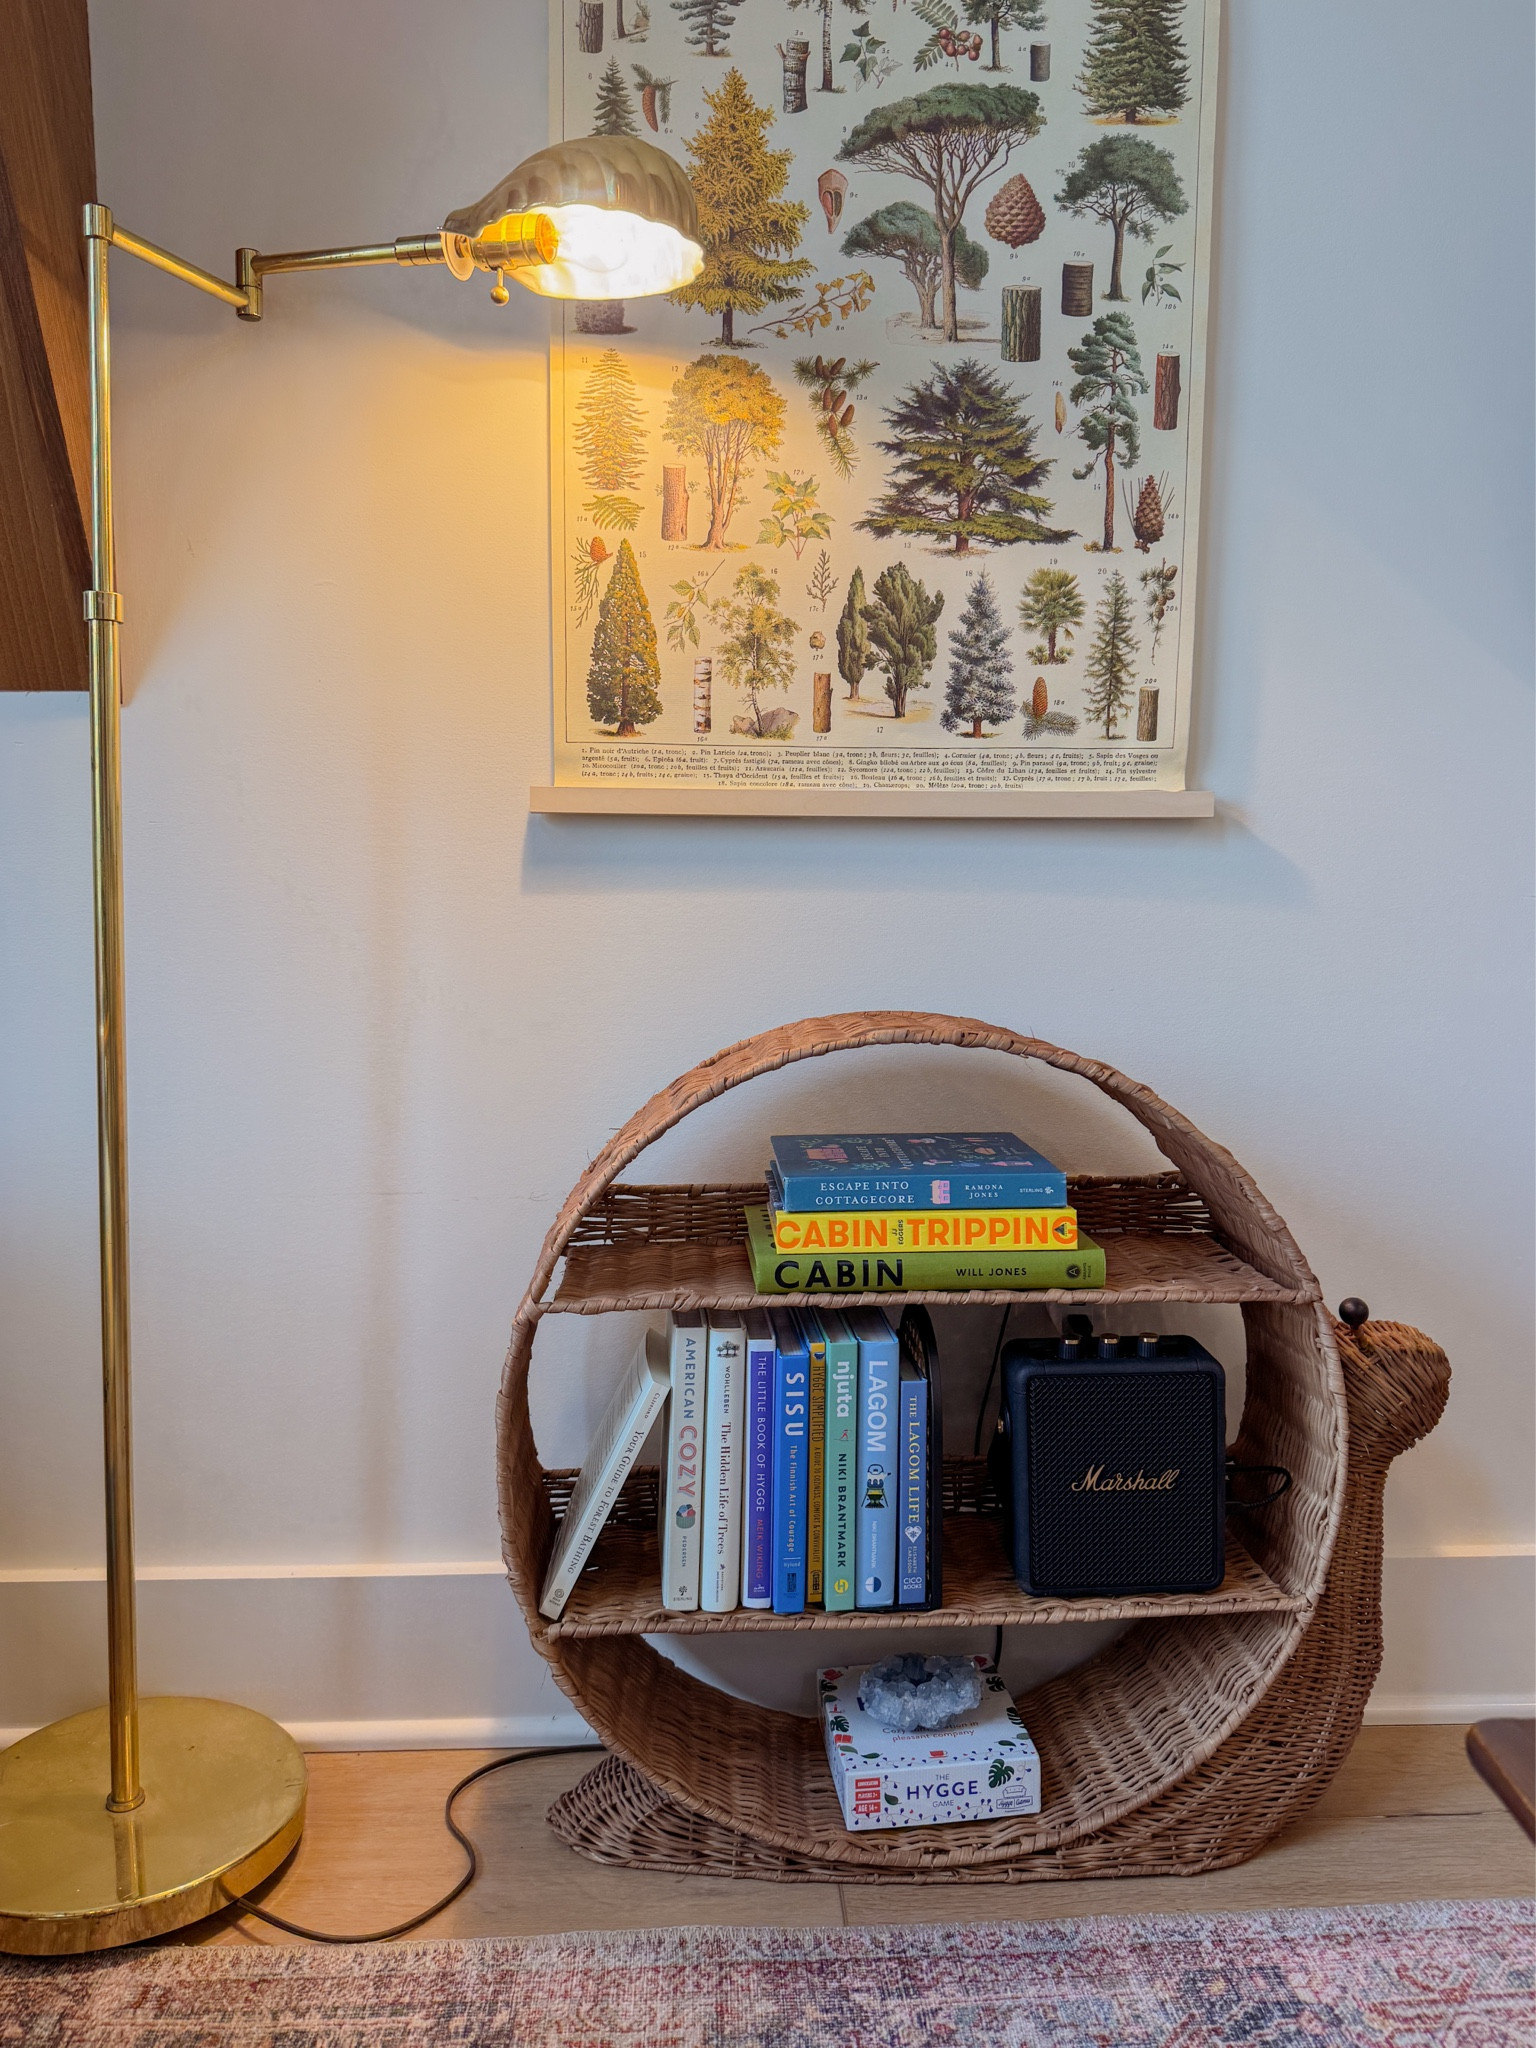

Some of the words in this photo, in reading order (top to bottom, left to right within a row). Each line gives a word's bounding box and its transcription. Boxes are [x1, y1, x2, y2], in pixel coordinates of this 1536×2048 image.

[816, 1194, 915, 1206] COTTAGECORE
[820, 1182, 871, 1192] ESCAPE
[876, 1181, 909, 1191] INTO
[969, 1191, 999, 1199] JONES
[776, 1219, 888, 1249] CABIN
[906, 1216, 1078, 1246] TRIPPING
[774, 1259, 904, 1289] CABIN
[956, 1268, 984, 1276] WILL
[988, 1267, 1027, 1276] JONES
[684, 1338, 696, 1419] AMERICAN
[757, 1356, 767, 1376] THE
[812, 1366, 825, 1392] HYGGE
[758, 1381, 766, 1412] LITTLE
[784, 1372, 805, 1436] SISU
[832, 1361, 854, 1418] njuta
[644, 1393, 660, 1419] CLIFFORD
[812, 1396, 824, 1442] SIMPLIFIED
[867, 1360, 888, 1452] LAGOM
[909, 1395, 918, 1418] THE
[624, 1430, 644, 1455] YOUR
[721, 1422, 732, 1443] The
[757, 1418, 766, 1449] BOOK
[678, 1425, 698, 1497] COZY
[720, 1446, 731, 1485] Hidden
[757, 1454, 766, 1468] OF
[908, 1422, 920, 1480] LAGOM
[611, 1456, 631, 1484] GUIDE
[838, 1454, 847, 1480] NIKI
[1071, 1464, 1181, 1491] Marshall
[719, 1488, 729, 1510] Life
[756, 1474, 766, 1512] HYGGE
[908, 1486, 920, 1524] LIFE
[588, 1500, 610, 1533] FOREST
[718, 1510, 728, 1523] of
[789, 1509, 797, 1517] of
[837, 1486, 846, 1568] BRANTMARK
[718, 1523, 728, 1555] Trees
[787, 1520, 796, 1553] Courage
[567, 1534, 593, 1574] BATHING
[756, 1544, 764, 1579] WIKING
[892, 1733, 929, 1742] pleasant
[933, 1729, 975, 1738] company
[907, 1781, 979, 1800] HYGGE
